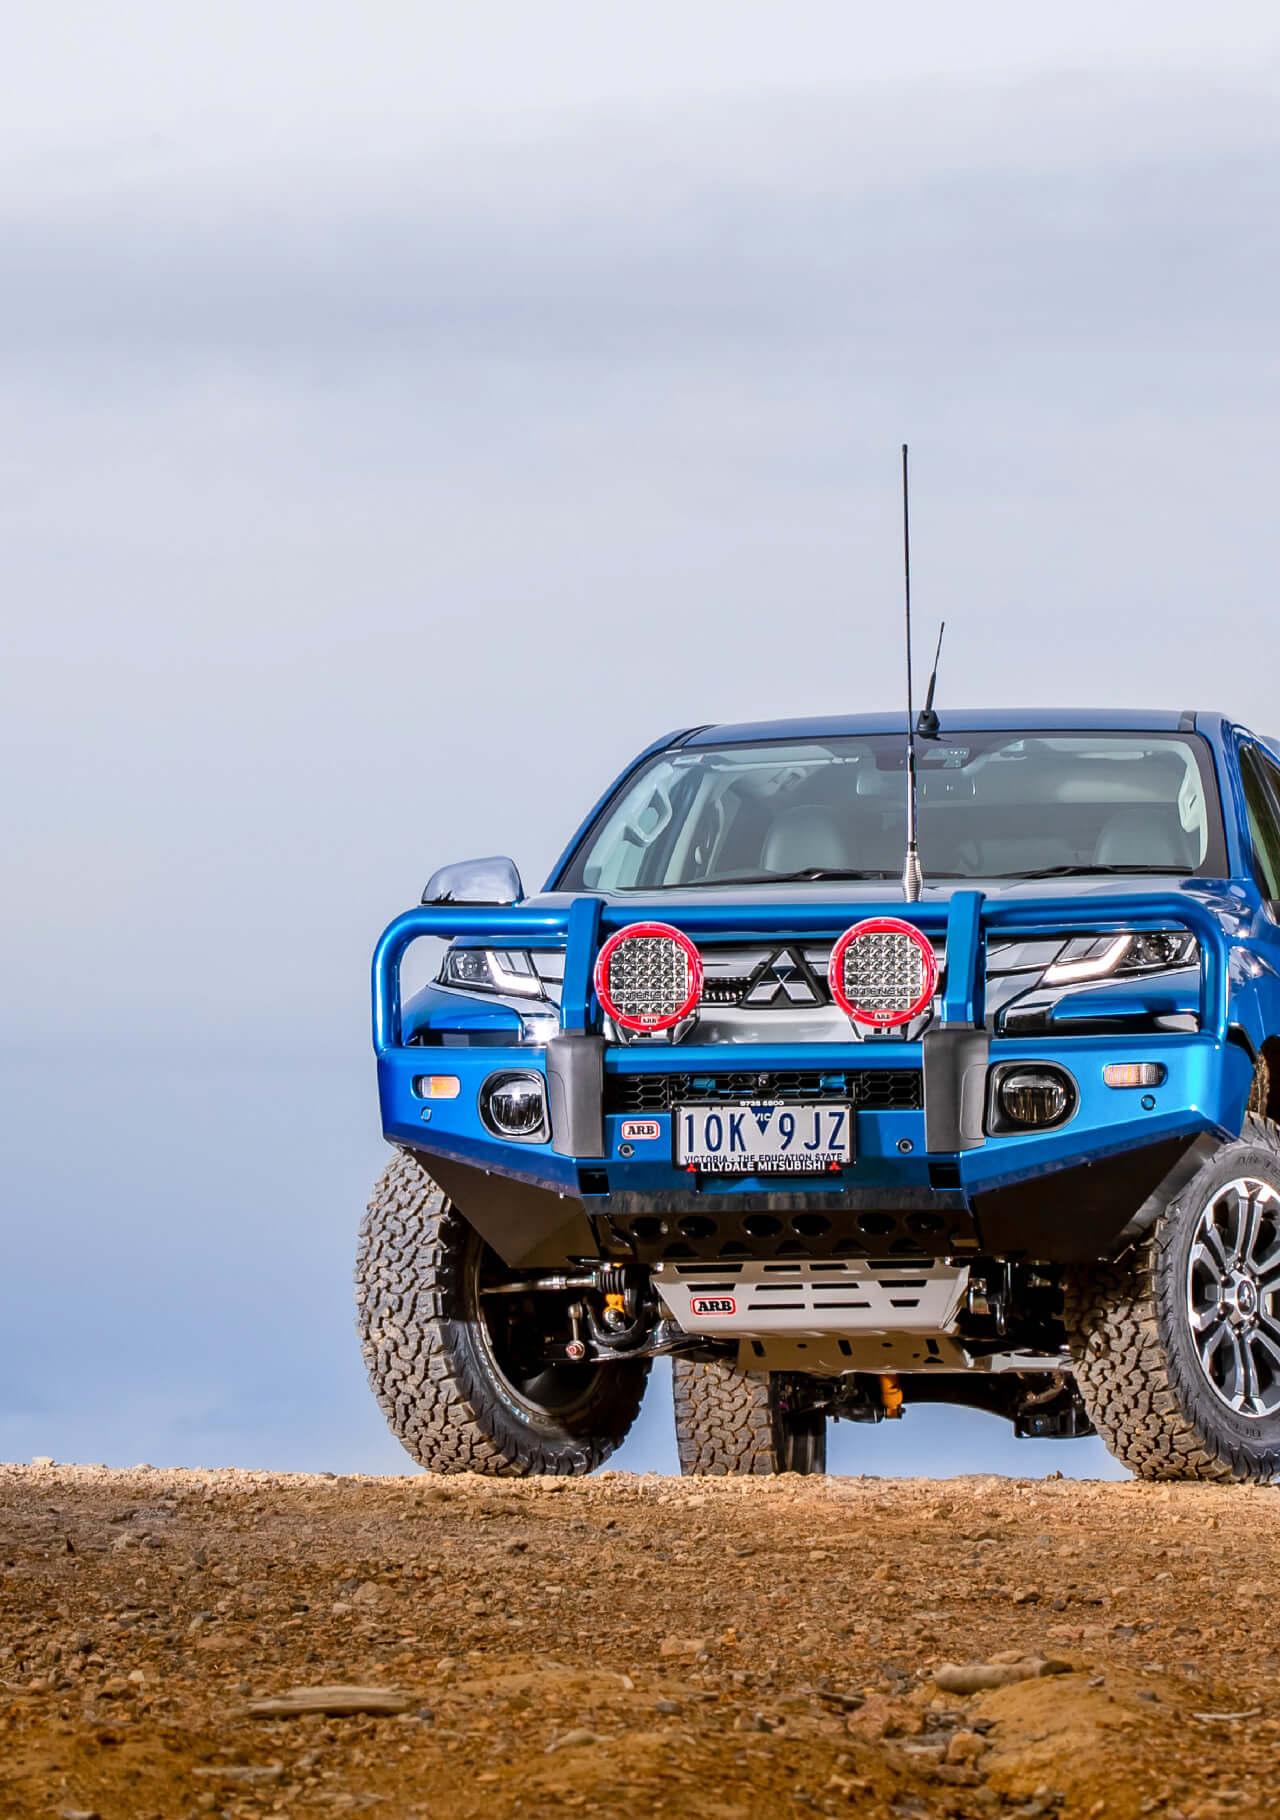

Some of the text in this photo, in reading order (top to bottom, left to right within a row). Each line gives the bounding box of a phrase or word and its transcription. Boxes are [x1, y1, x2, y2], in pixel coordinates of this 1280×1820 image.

[752, 1113, 771, 1121] VIC
[627, 1125, 656, 1136] ARB
[778, 1111, 846, 1151] 9JZ
[684, 1155, 728, 1163] VICTORIA
[738, 1154, 756, 1162] THE
[758, 1153, 812, 1162] EDUCATION
[815, 1152, 843, 1161] STATE
[699, 1160, 826, 1172] LILYDALE MITSUBISHI
[697, 1300, 732, 1312] ARB
